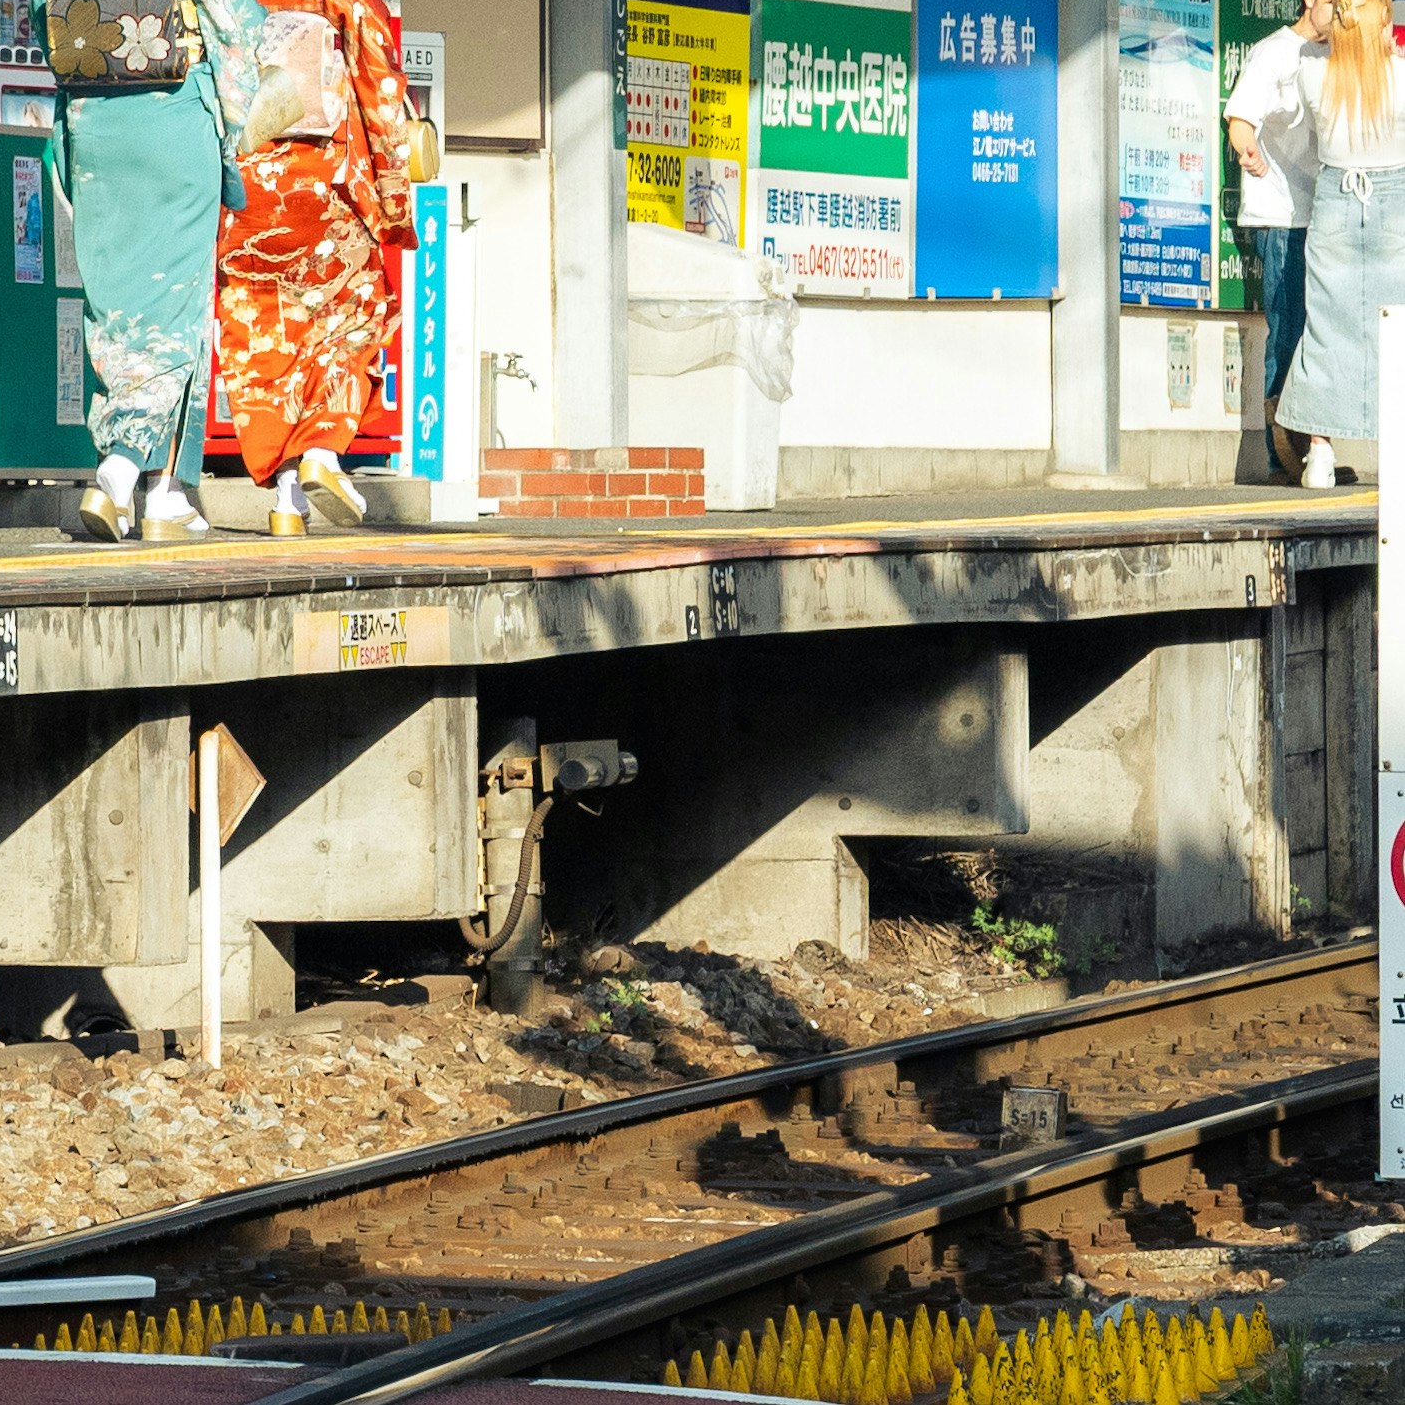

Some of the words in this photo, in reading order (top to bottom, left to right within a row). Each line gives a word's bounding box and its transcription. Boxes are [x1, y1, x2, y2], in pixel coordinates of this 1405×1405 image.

[939, 10, 1036, 67] 広告募集中
[405, 50, 434, 66] AED
[762, 40, 908, 137] 腰越中央医院
[972, 109, 1014, 133] お問い合わせ
[698, 133, 741, 152] コンタクトレンズ
[972, 135, 1037, 158] 江ノ電エリアサービス
[766, 188, 902, 233] 腰越駅下車腰越消防署前
[792, 252, 808, 275] TEL
[423, 215, 438, 379] 傘レンタル
[350, 612, 399, 641] 退避スペース
[360, 646, 390, 665] ESCAPE
[1011, 1107, 1048, 1129] S=15
